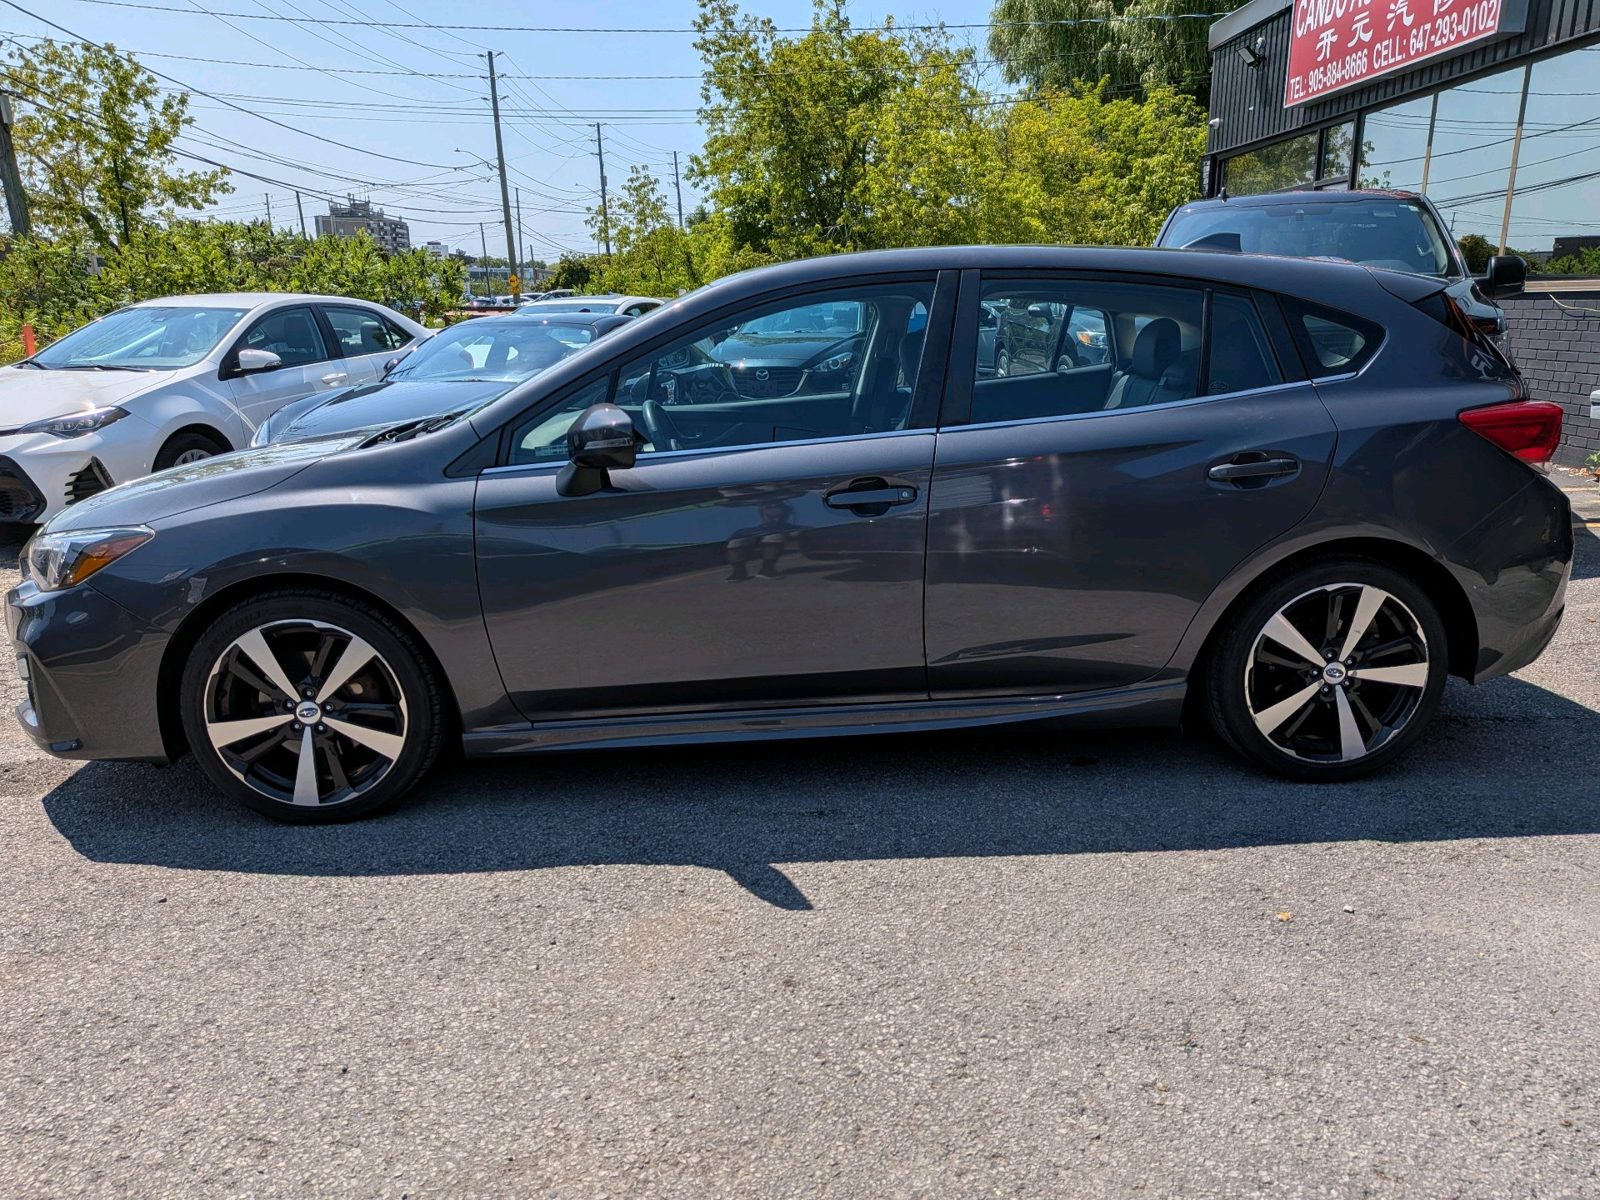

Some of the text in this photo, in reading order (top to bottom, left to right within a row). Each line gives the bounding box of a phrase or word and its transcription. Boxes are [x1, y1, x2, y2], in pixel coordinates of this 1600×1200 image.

[1290, 0, 1497, 100] TEL: 905-884-8666 CELL: 647-293-0102
